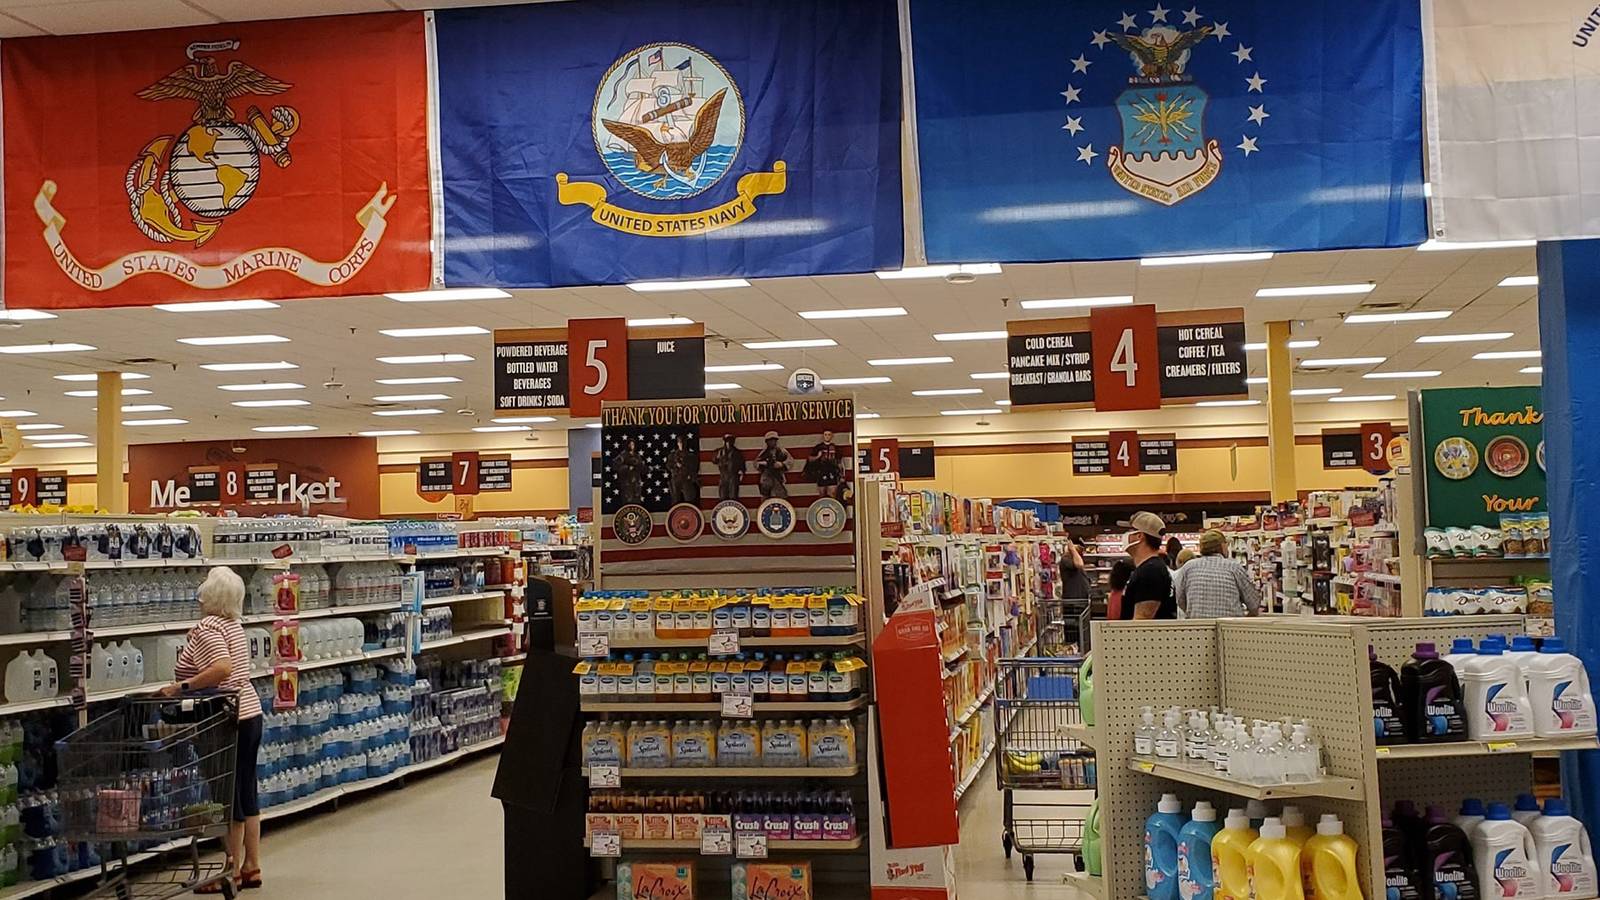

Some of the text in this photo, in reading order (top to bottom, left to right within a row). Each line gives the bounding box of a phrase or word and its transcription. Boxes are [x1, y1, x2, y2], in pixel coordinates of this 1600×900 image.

[1572, 4, 1600, 47] UNIT
[599, 201, 747, 233] UNITED STATES NAVY
[53, 237, 375, 289] UNITED STATES MARINE CORPS
[1178, 326, 1224, 341] HOT CEREAL
[657, 341, 676, 354] JUICE
[1025, 335, 1073, 350] COLD CEREAL
[496, 344, 568, 358] POWDERED BEVERAGE
[1110, 328, 1138, 387] 4
[1178, 346, 1205, 359] COFFEE
[1211, 344, 1226, 357] TEA
[506, 361, 558, 374] BOTTLED WATER
[583, 339, 608, 395] 5
[1011, 356, 1045, 369] PANCAKE
[1046, 355, 1061, 367] MIX
[1065, 353, 1090, 365] SYRUP
[1011, 373, 1043, 386] BREAKFAST
[1047, 371, 1075, 384] GRANOLA
[1075, 369, 1092, 382] BARS
[1165, 364, 1207, 378] CREAMERS
[1211, 361, 1241, 376] FILTERS
[513, 377, 552, 390] BEVERAGES
[499, 395, 516, 408] SOFT
[517, 395, 542, 407] DRINKS
[547, 394, 565, 406] SODA
[602, 399, 852, 427] THANK YOU FOR YOUR MILITARY SERVICE
[1459, 405, 1544, 427] Thank
[1116, 440, 1130, 467] 4
[1369, 432, 1384, 460] 3
[879, 447, 891, 473] 5
[226, 465, 238, 496] 8
[459, 460, 470, 487] 7
[17, 477, 29, 501] 9
[150, 479, 191, 508] Me
[276, 473, 341, 505] rket
[1482, 494, 1539, 513] Your
[1372, 706, 1393, 717] olite
[1427, 704, 1455, 716] Woolite
[1487, 701, 1517, 713] Woolite
[735, 820, 760, 830] Crush
[764, 820, 789, 830] Crush
[794, 820, 819, 830] Crush
[823, 820, 848, 830] Crush
[1386, 875, 1409, 887] oolite
[1435, 870, 1465, 882] Woolite
